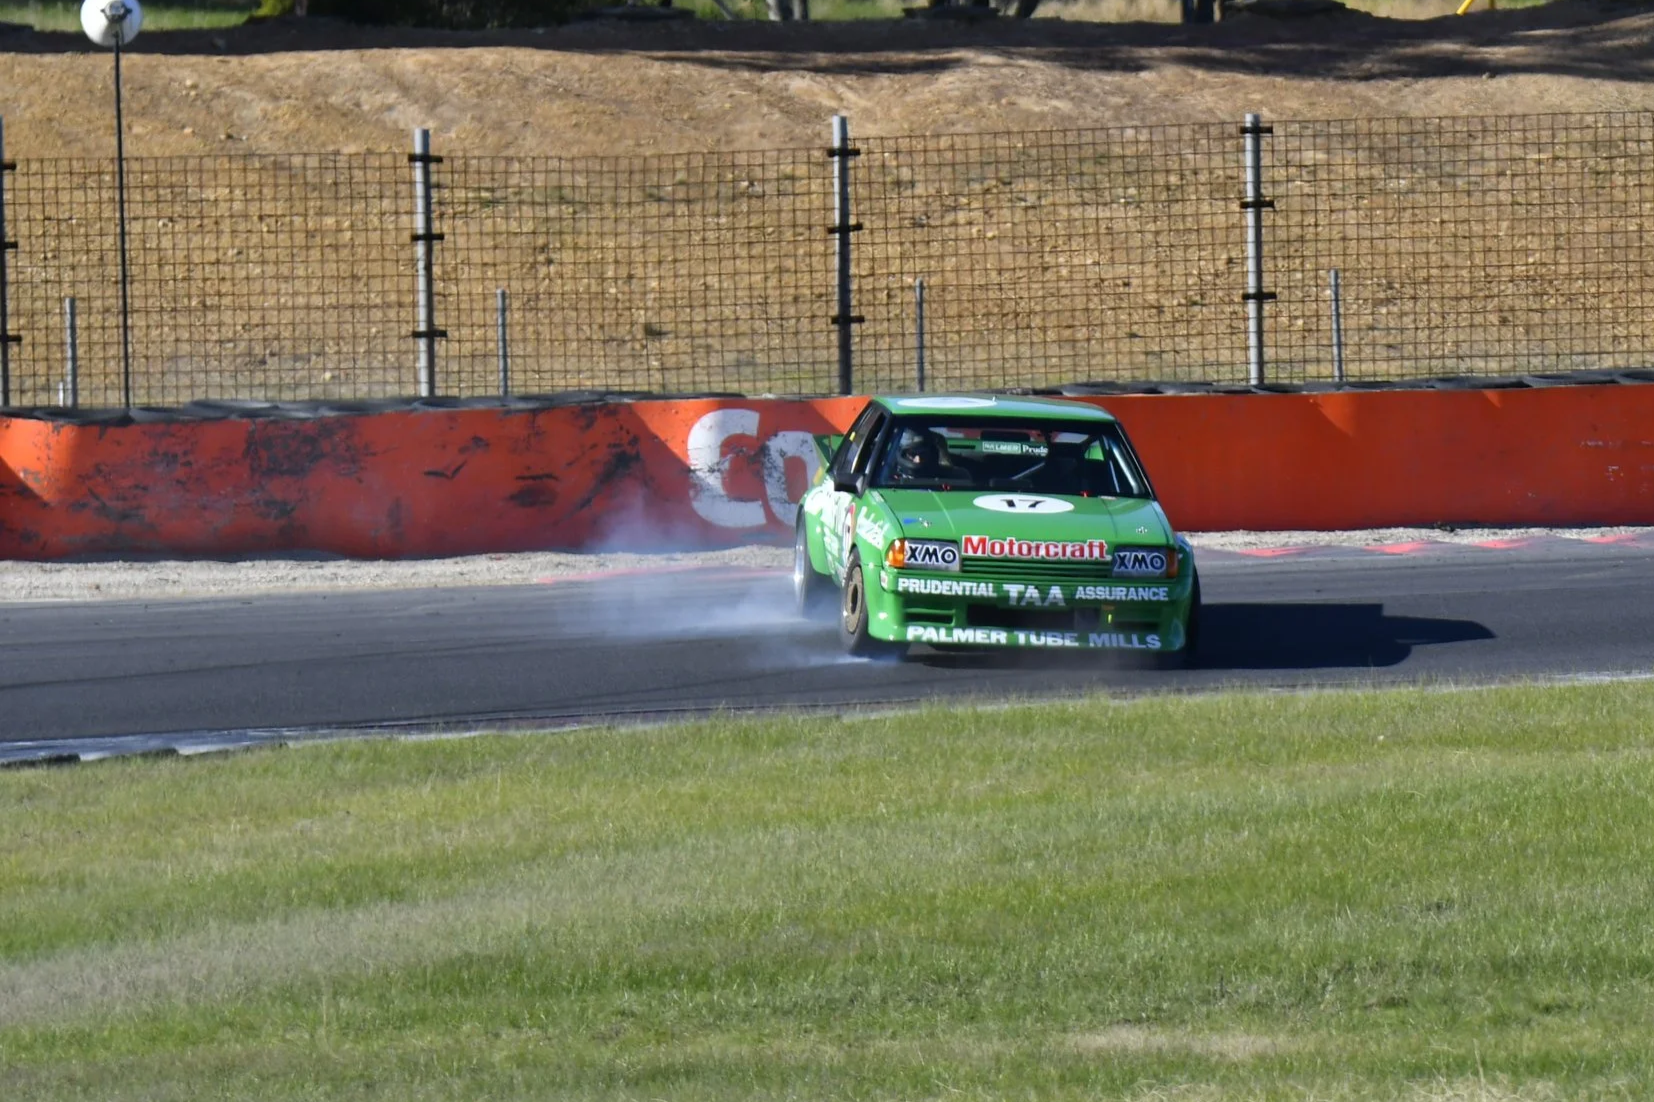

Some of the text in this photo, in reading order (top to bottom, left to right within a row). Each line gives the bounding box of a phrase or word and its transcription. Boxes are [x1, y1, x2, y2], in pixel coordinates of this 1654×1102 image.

[1000, 499, 1046, 508] 17
[905, 544, 958, 564] XMO
[962, 535, 1108, 560] Motorcraft
[1114, 551, 1166, 572] XMO
[898, 577, 997, 597] PRUDENTIAL
[1003, 583, 1066, 606] TAA
[1075, 585, 1169, 601] ASSURANCE
[906, 625, 1162, 649] PALMER TUBE MILLS
